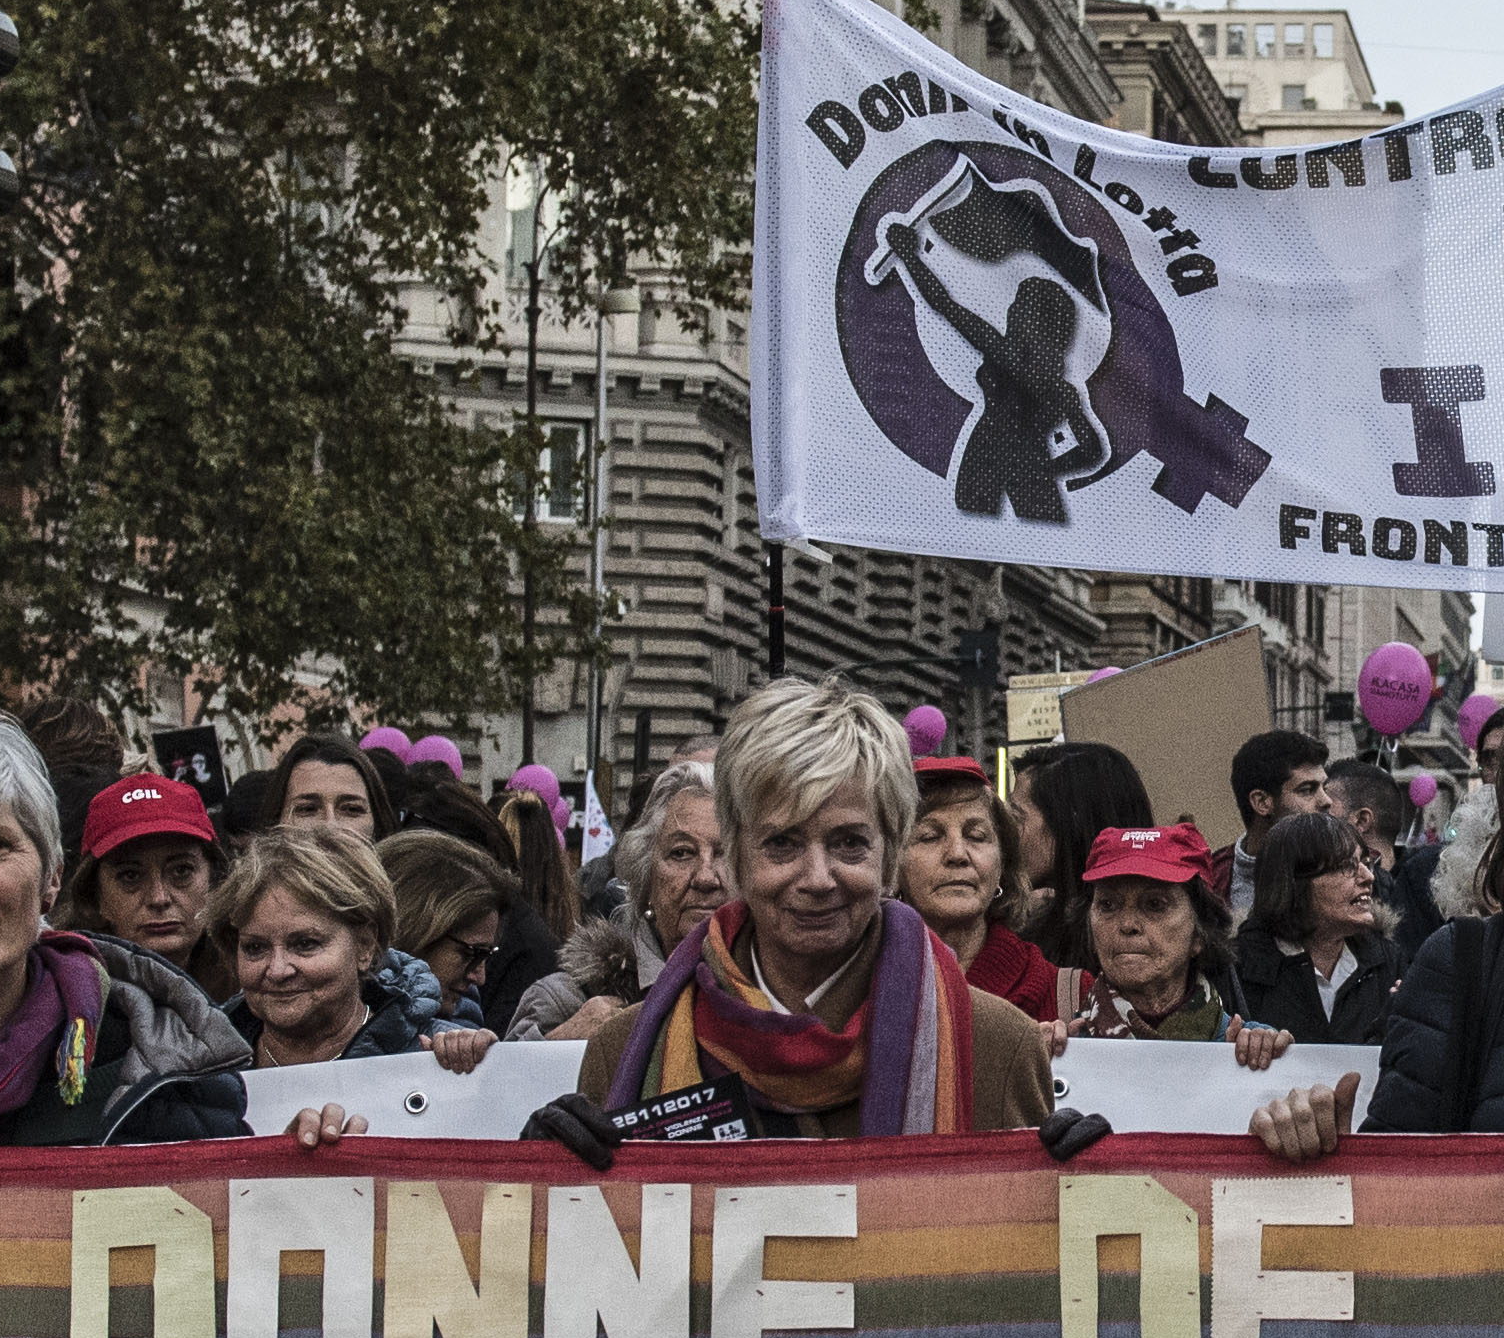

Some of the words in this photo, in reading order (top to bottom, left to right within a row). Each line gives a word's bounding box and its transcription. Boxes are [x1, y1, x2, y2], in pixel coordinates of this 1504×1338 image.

[805, 70, 970, 170] Donn
[1073, 143, 1219, 297] Lotta
[122, 788, 163, 804] CGIL
[612, 1087, 715, 1129] 25112017
[664, 1114, 709, 1132] VIOLENZA
[667, 1123, 704, 1139] DONNE
